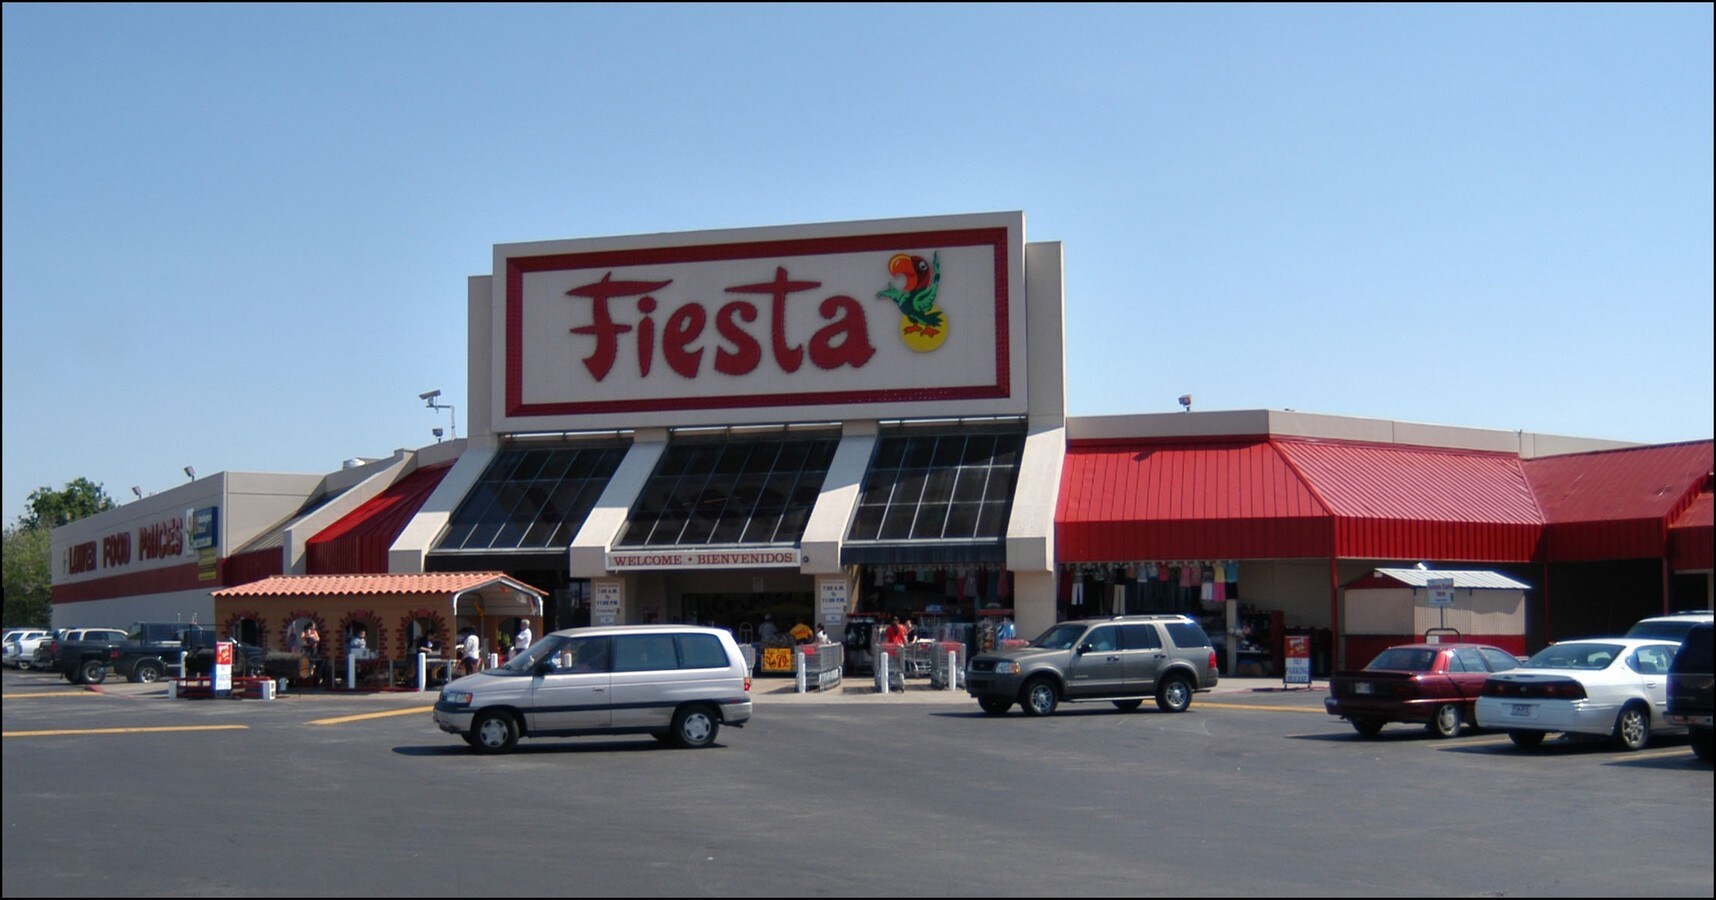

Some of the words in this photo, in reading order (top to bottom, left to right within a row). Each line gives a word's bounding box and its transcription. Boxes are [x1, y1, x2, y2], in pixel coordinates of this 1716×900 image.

[565, 265, 876, 382] Fiesta
[69, 541, 97, 575] LOWER
[103, 531, 131, 569] FOOD
[139, 517, 183, 561] PRICES
[613, 555, 682, 567] WELCOME
[697, 553, 793, 565] BIENVENIDOS
